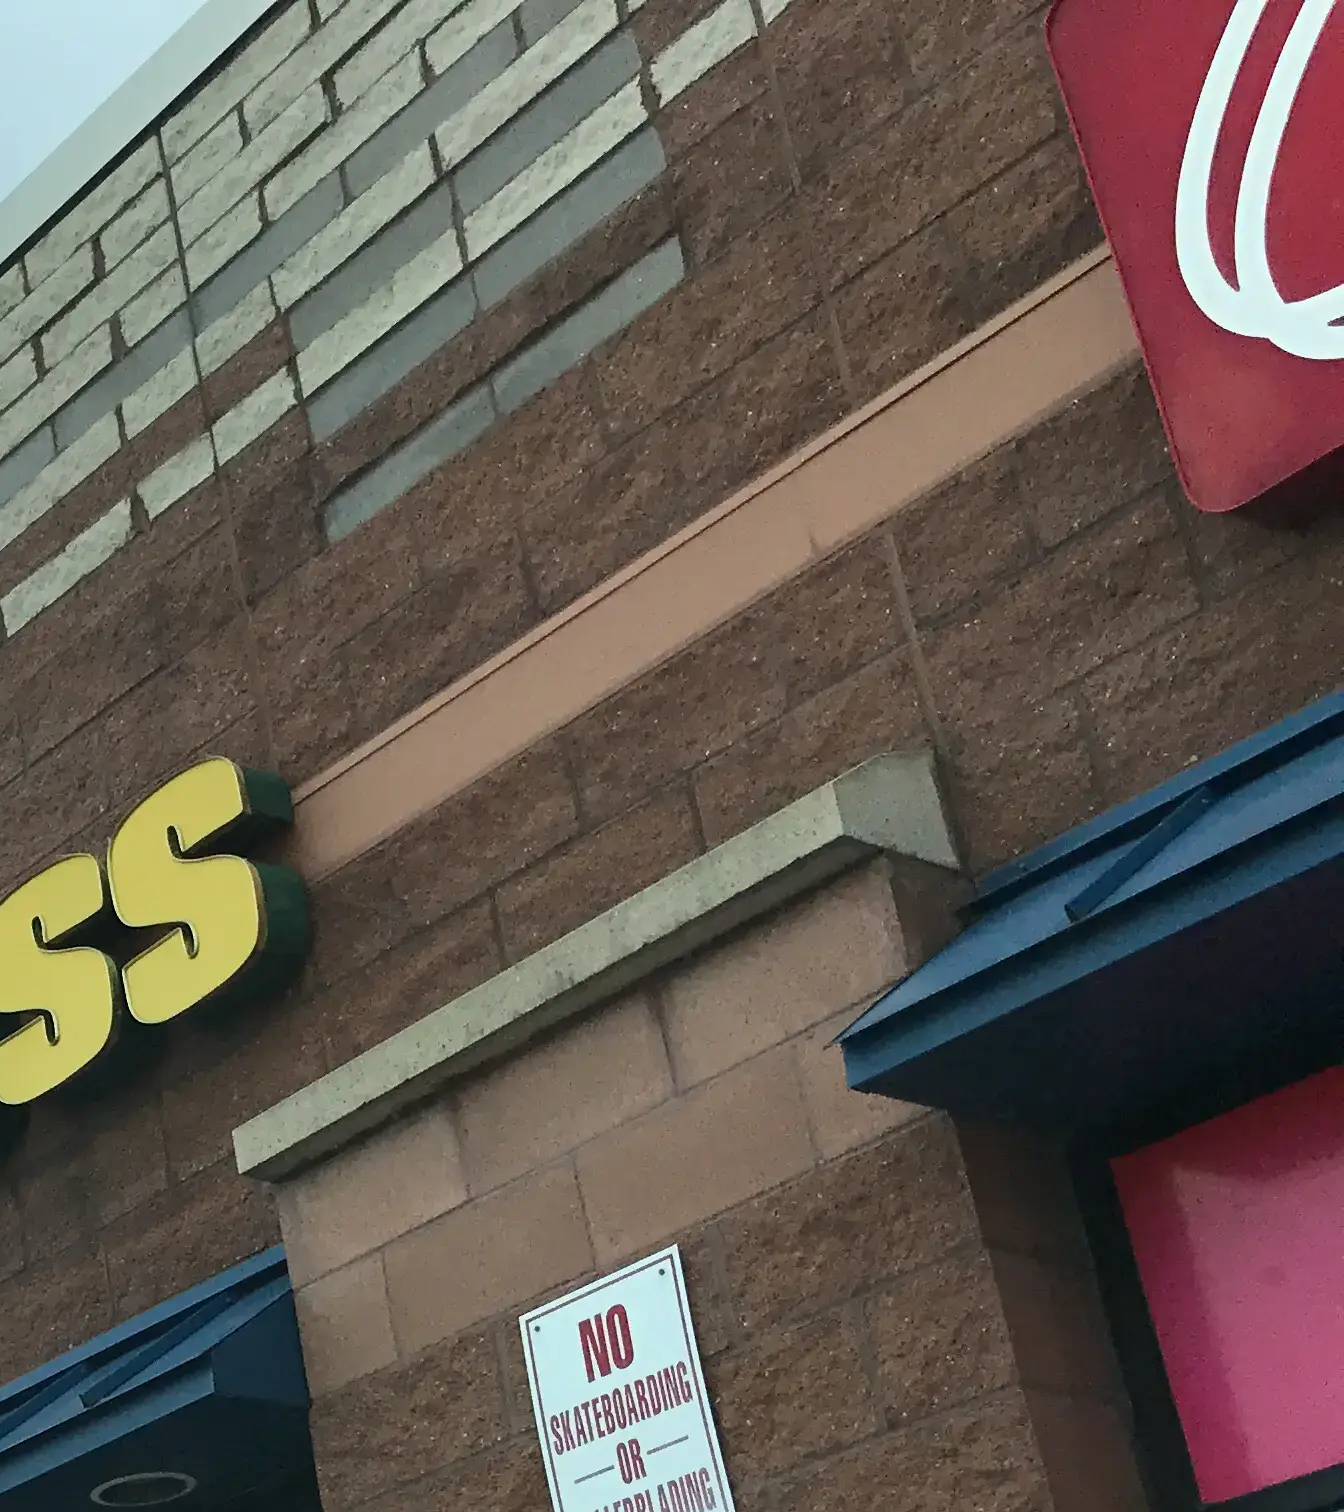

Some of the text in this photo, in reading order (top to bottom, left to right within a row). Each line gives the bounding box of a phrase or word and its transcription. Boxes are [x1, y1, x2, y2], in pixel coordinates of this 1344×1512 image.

[578, 1304, 634, 1383] NO
[550, 1360, 693, 1455] SKATEBOARDING
[616, 1439, 647, 1484] OR
